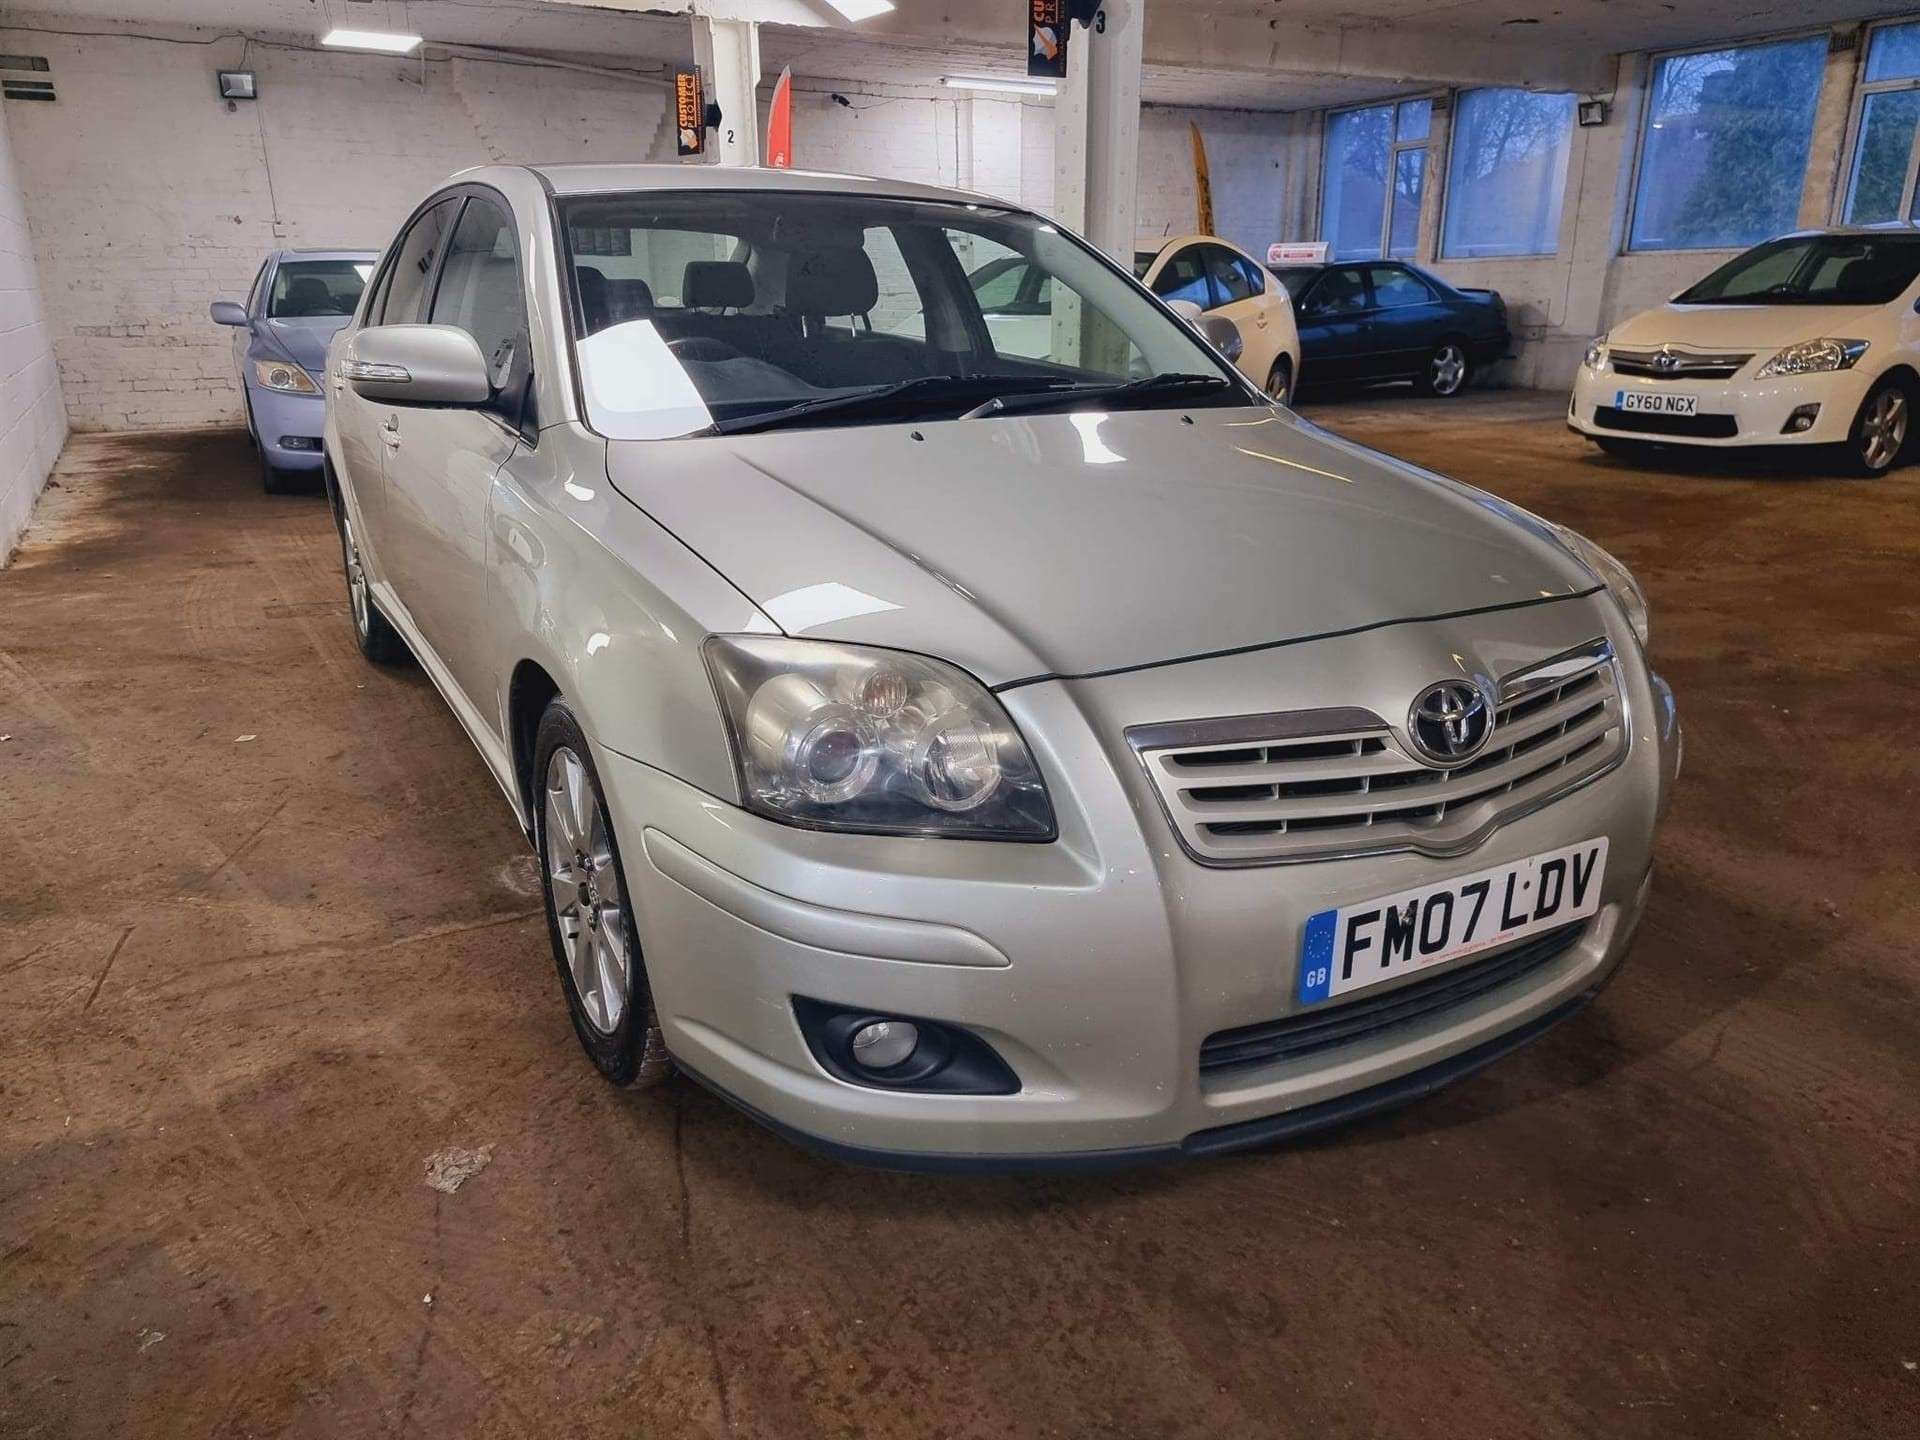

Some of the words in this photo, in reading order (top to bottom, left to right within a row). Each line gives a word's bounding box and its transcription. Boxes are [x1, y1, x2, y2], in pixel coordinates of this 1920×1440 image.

[1096, 10, 1106, 34] 3
[677, 74, 688, 128] CUSTOMER
[686, 75, 695, 129] PROTECT
[727, 130, 735, 144] 2
[1626, 394, 1663, 410] GY60
[1665, 397, 1695, 412] NGX
[1342, 880, 1491, 980] FM07
[1501, 848, 1599, 931] LDV
[1306, 967, 1327, 988] GB
